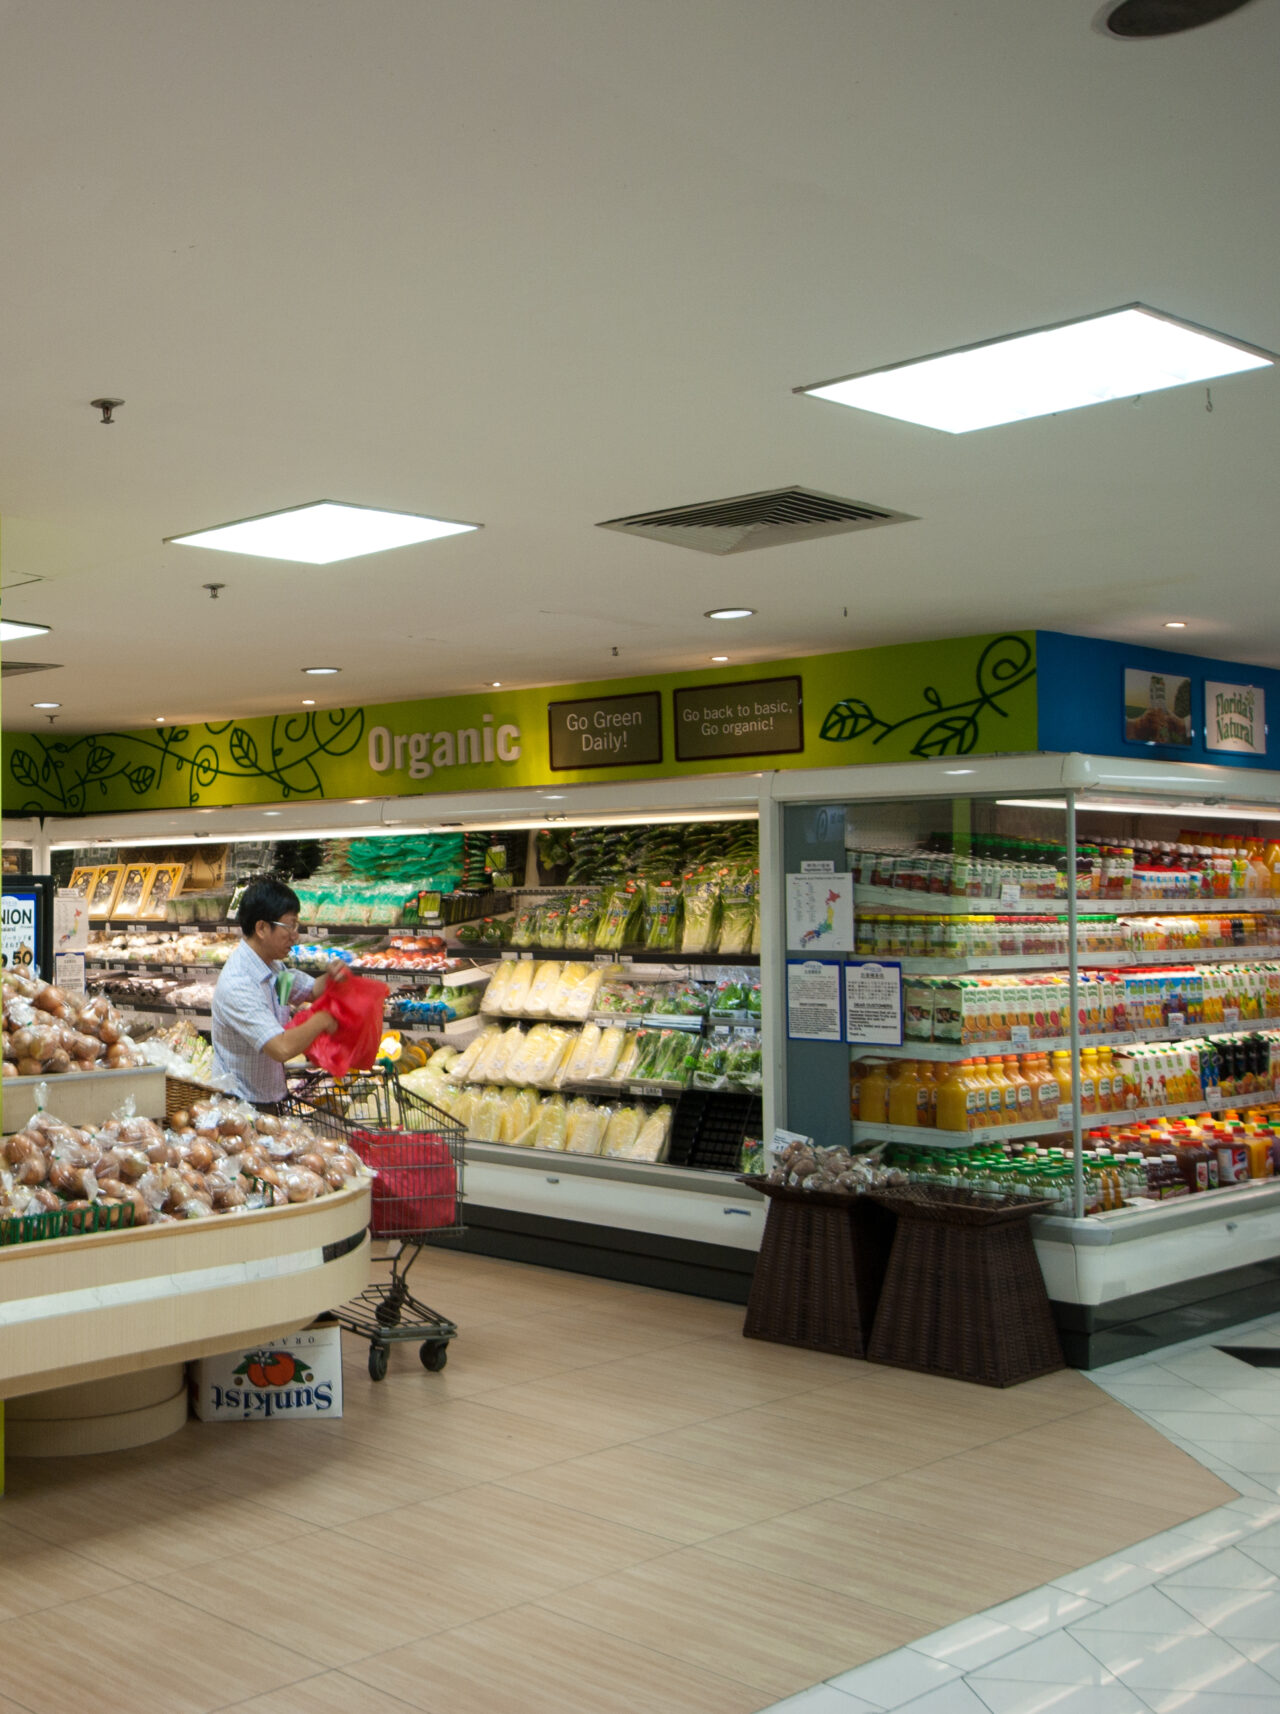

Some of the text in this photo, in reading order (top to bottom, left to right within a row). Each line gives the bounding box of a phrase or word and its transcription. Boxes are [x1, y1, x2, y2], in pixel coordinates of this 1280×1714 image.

[683, 702, 792, 721] Go back to basic,
[1215, 691, 1254, 723] Florida's
[567, 711, 642, 731] Go Green
[701, 717, 773, 736] Go organic!
[1216, 717, 1255, 748] Natural
[368, 714, 521, 779] Organic
[582, 731, 627, 752] Daily!
[211, 1380, 333, 1417] Sunkist
